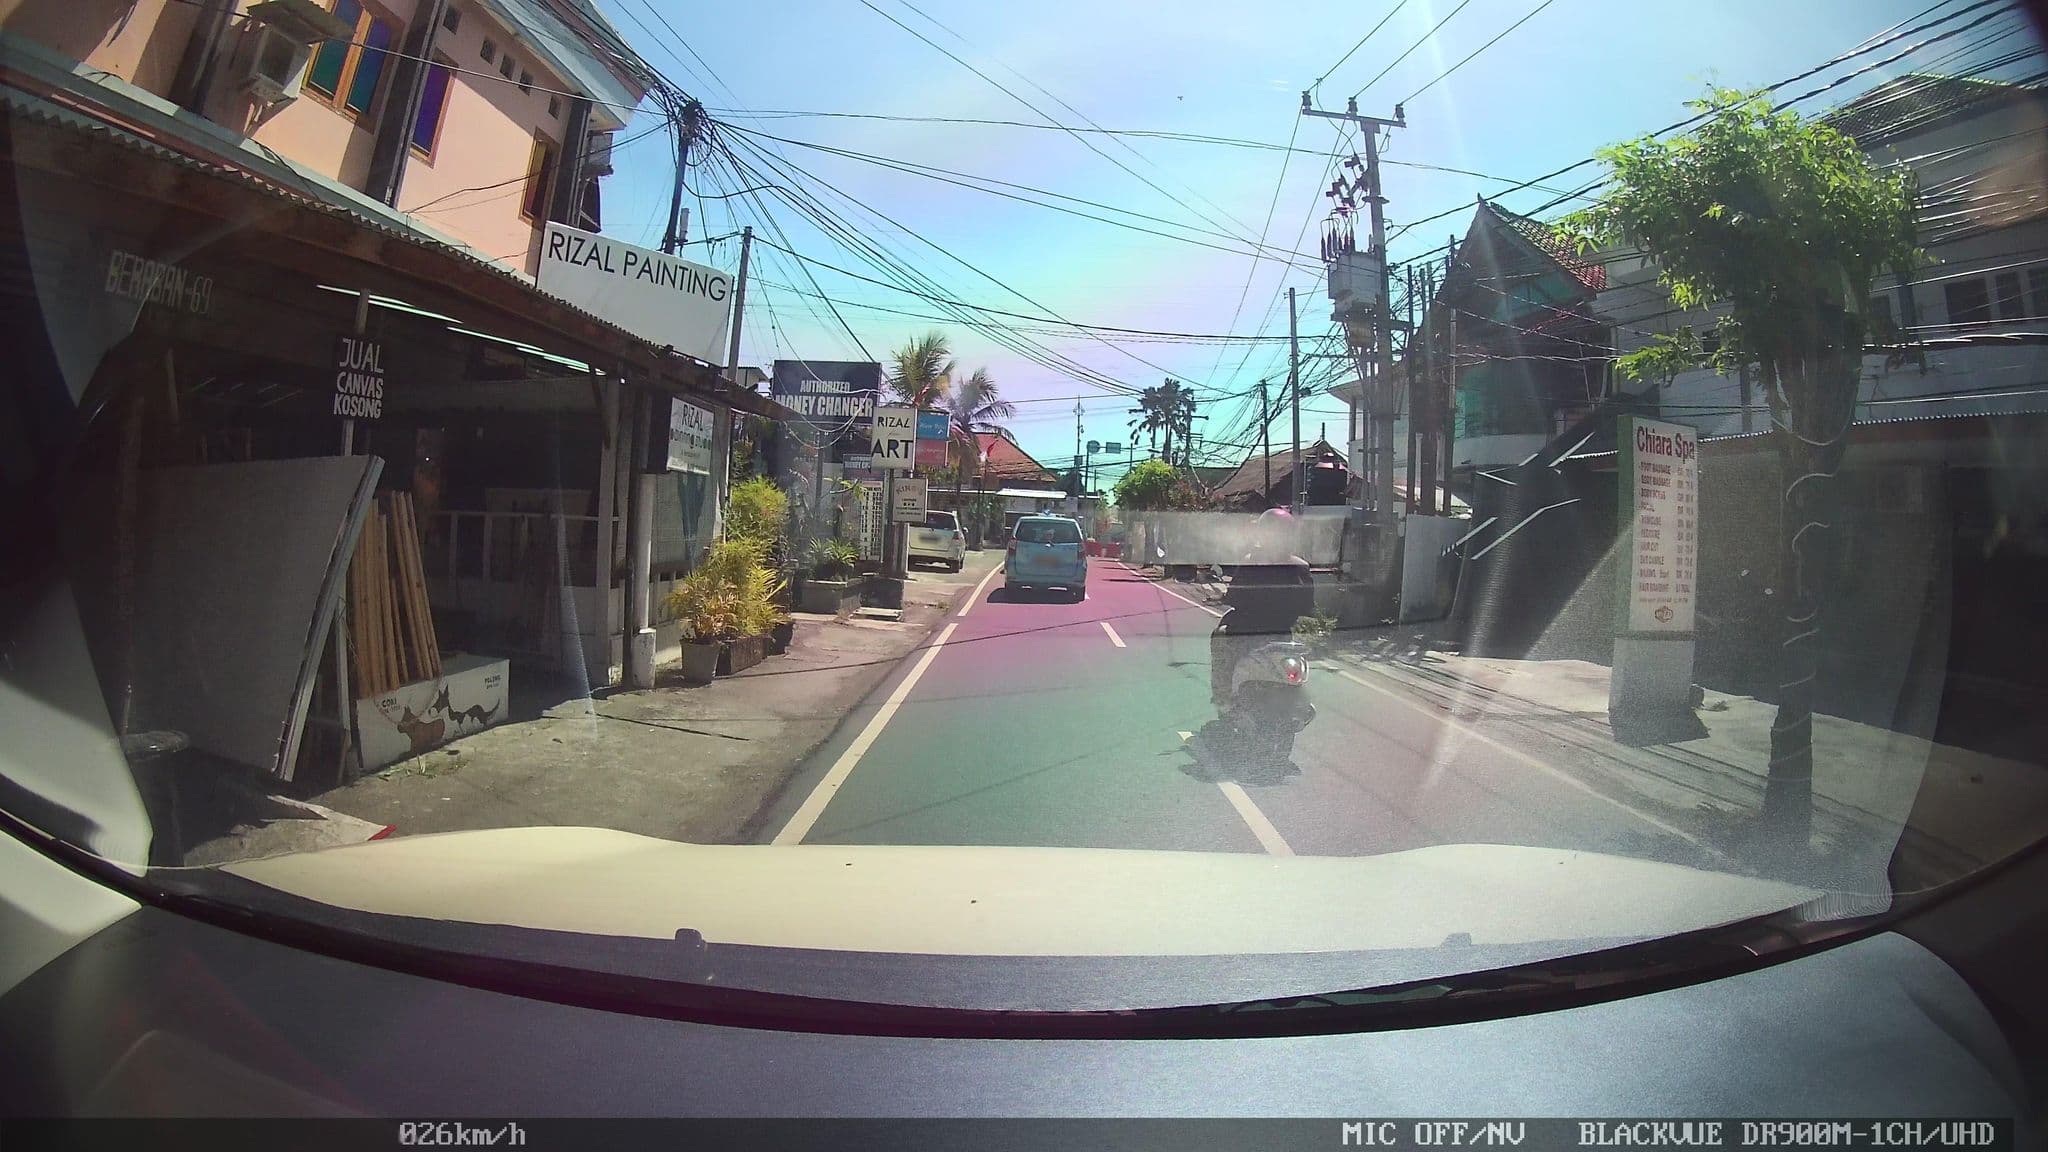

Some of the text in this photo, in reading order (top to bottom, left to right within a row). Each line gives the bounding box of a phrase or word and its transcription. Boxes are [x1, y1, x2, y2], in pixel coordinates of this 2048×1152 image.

[549, 231, 726, 301] RIZAL PAINTING
[340, 338, 384, 373] JUAL
[337, 371, 384, 399] CANVAS
[800, 380, 850, 393] AUTHORIZED
[334, 393, 382, 418] KOSONG
[682, 404, 703, 432] RIZAL
[817, 396, 873, 417] CHANGER
[877, 416, 910, 428] RIZAL
[871, 439, 914, 459] ART
[1637, 425, 1695, 464] Chiara Spa
